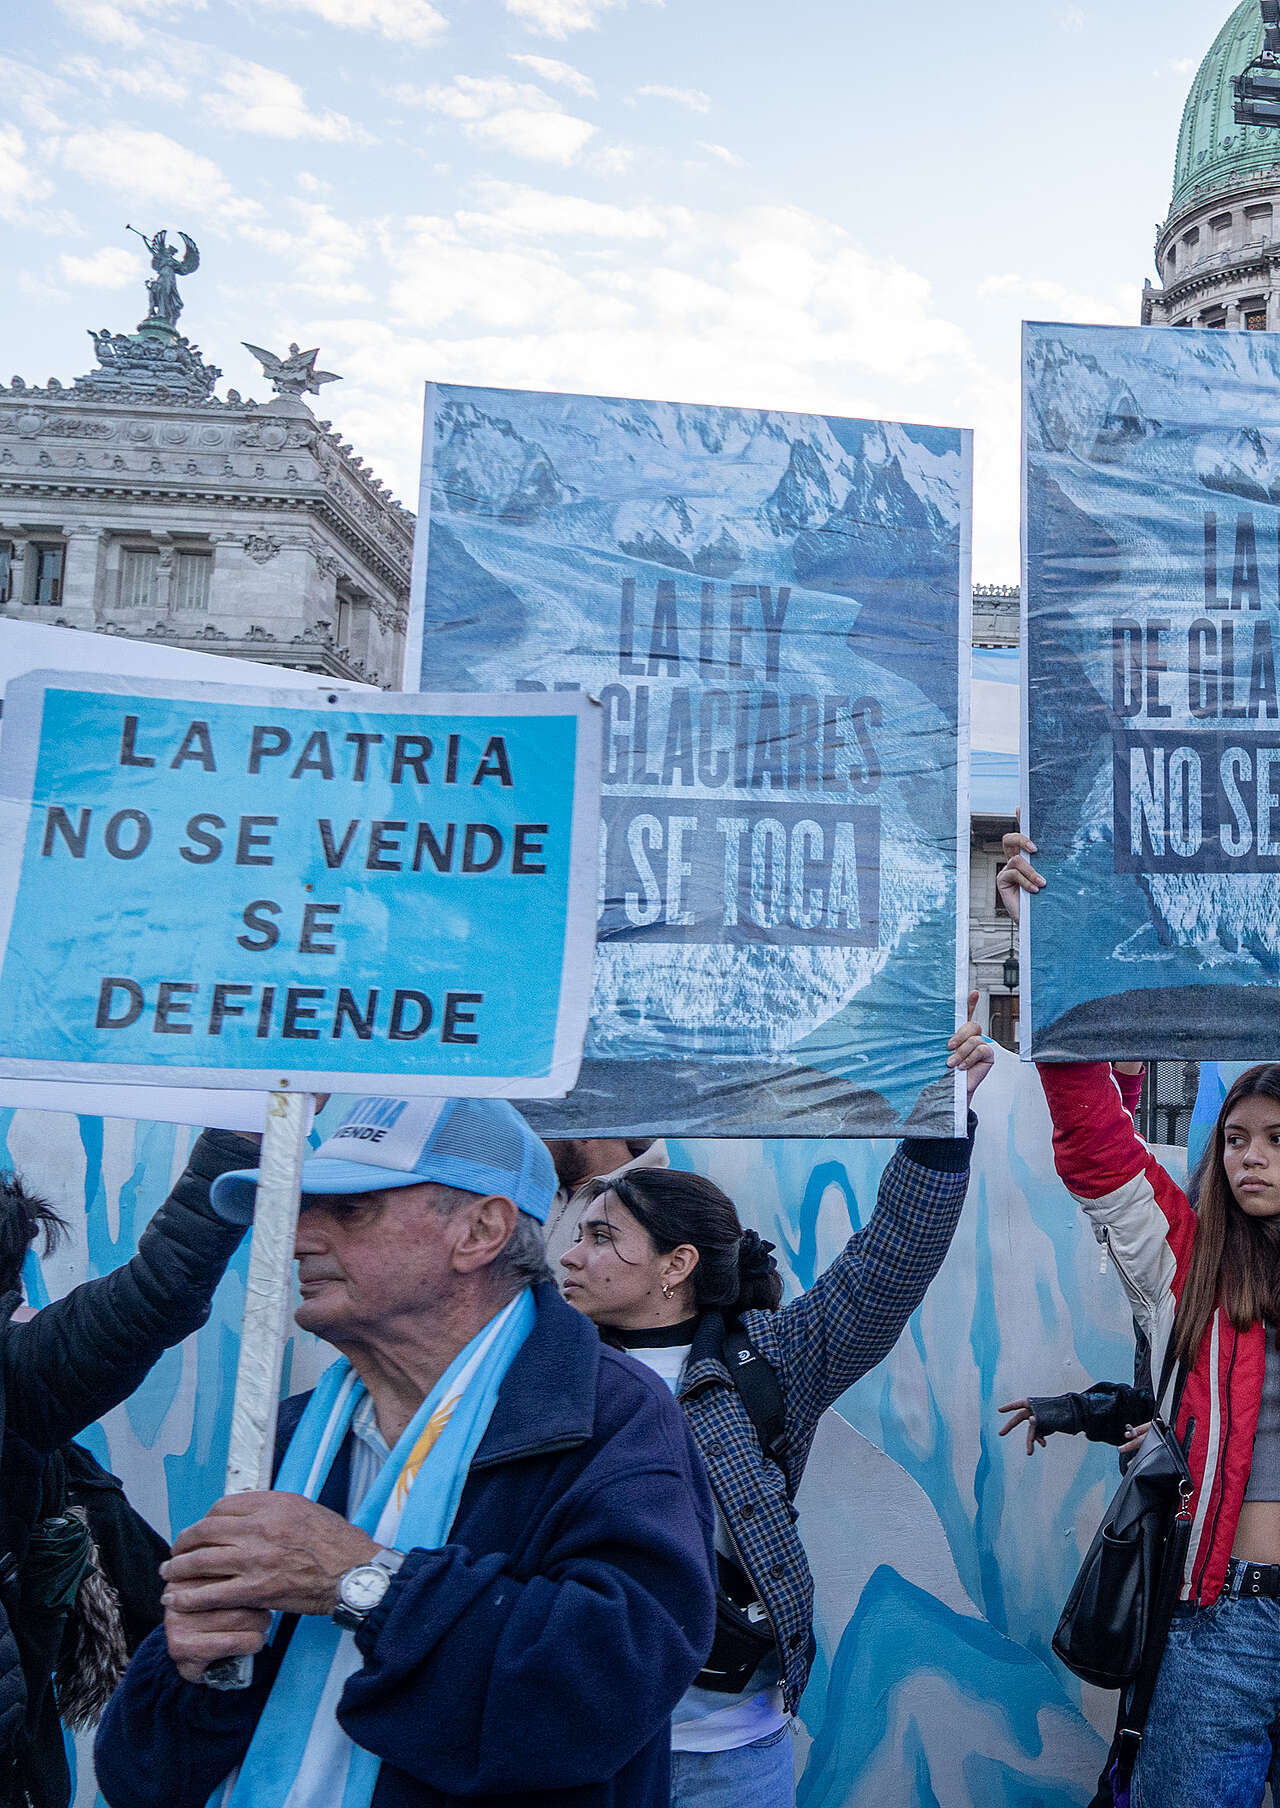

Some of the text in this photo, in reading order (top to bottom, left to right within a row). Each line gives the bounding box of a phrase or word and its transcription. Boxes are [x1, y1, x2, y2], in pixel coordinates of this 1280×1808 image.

[1205, 511, 1260, 609] LA
[619, 577, 791, 680] LA LEY
[1111, 618, 1176, 718] DE
[118, 715, 514, 787] LA PATRIA
[600, 683, 882, 795] GLACIARES
[41, 805, 153, 860] NO
[177, 812, 279, 867] SE
[317, 818, 549, 875] VENDE
[1130, 746, 1200, 858] NO
[624, 813, 698, 926] SE
[715, 817, 862, 931] TOCA
[236, 899, 341, 955] SE
[95, 976, 484, 1045] DEFIENDE
